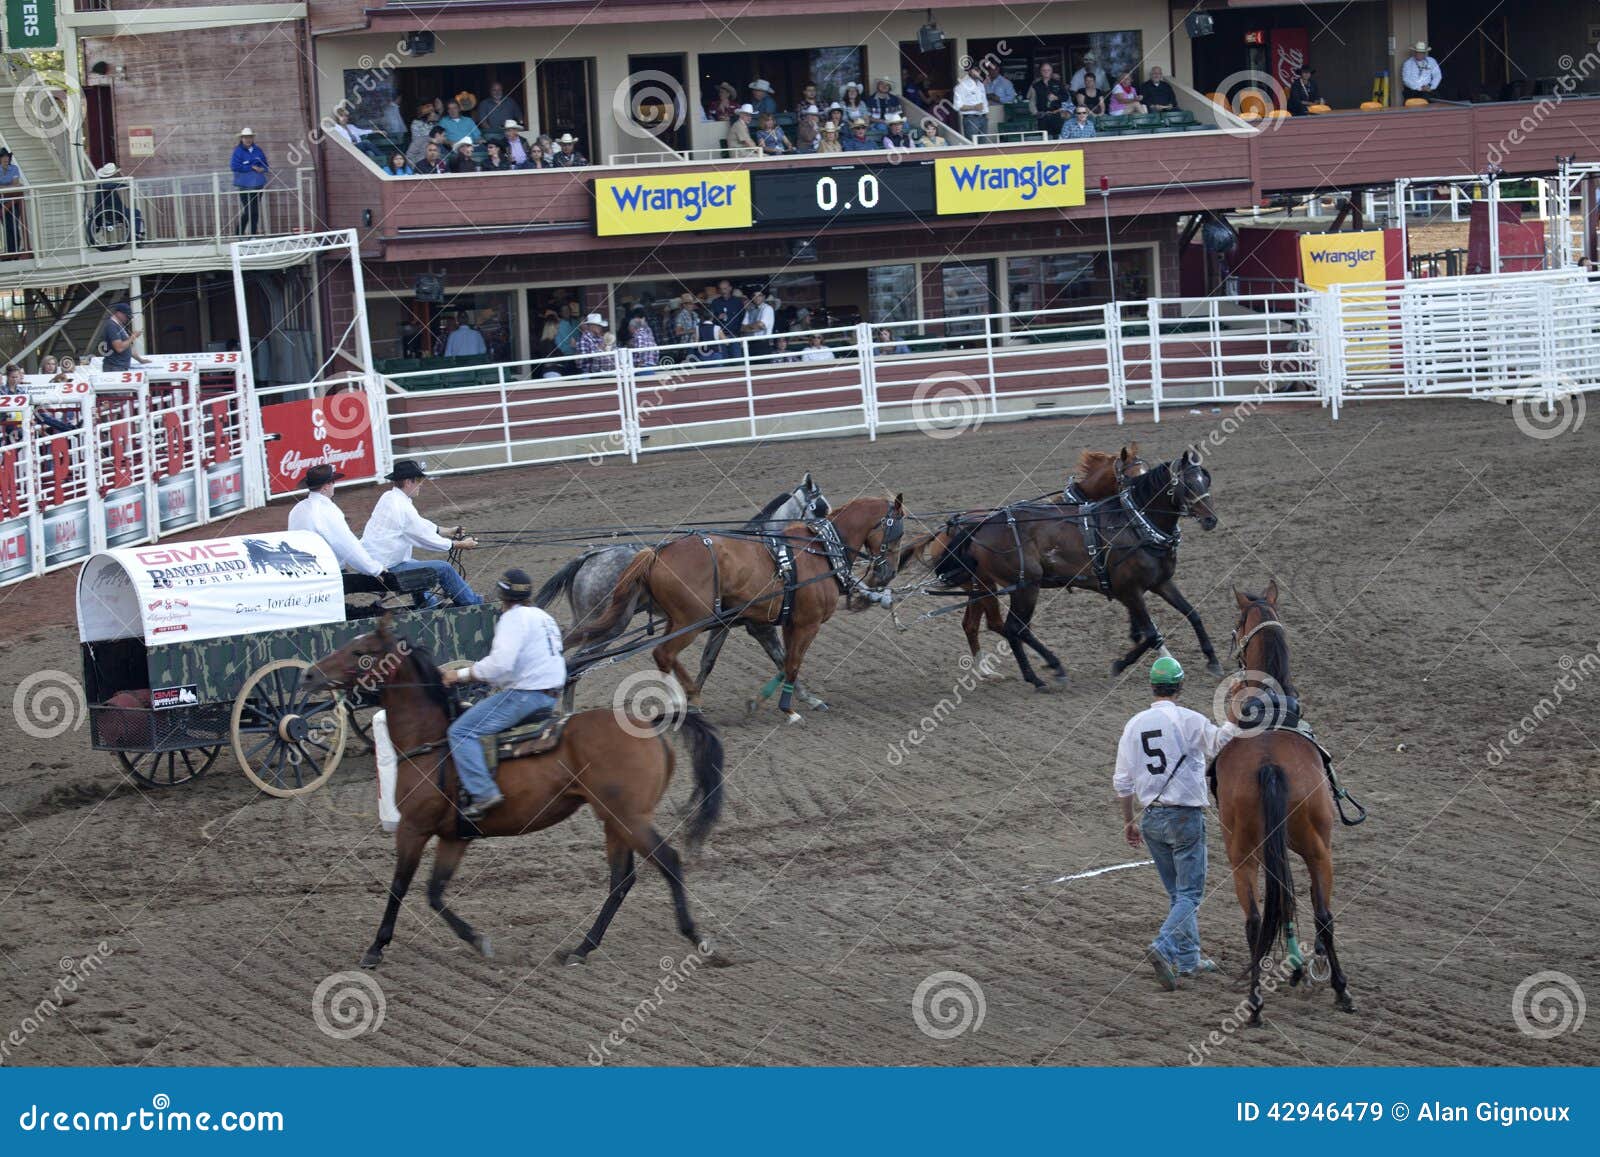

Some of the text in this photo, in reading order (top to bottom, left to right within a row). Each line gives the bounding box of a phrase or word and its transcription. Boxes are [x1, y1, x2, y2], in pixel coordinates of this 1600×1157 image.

[950, 160, 1070, 201] Wrangler
[611, 181, 736, 222] Wrangler
[816, 174, 879, 211] 0.0
[1309, 249, 1376, 268] Wrangler
[168, 362, 193, 372] 32
[214, 353, 238, 363] 33
[121, 372, 143, 383] 31
[61, 382, 89, 394] 30
[0, 395, 27, 408] 29
[136, 543, 239, 566] GMC
[146, 560, 246, 589] RANGELAND
[186, 572, 244, 587] DERBY
[1141, 729, 1168, 776] 5
